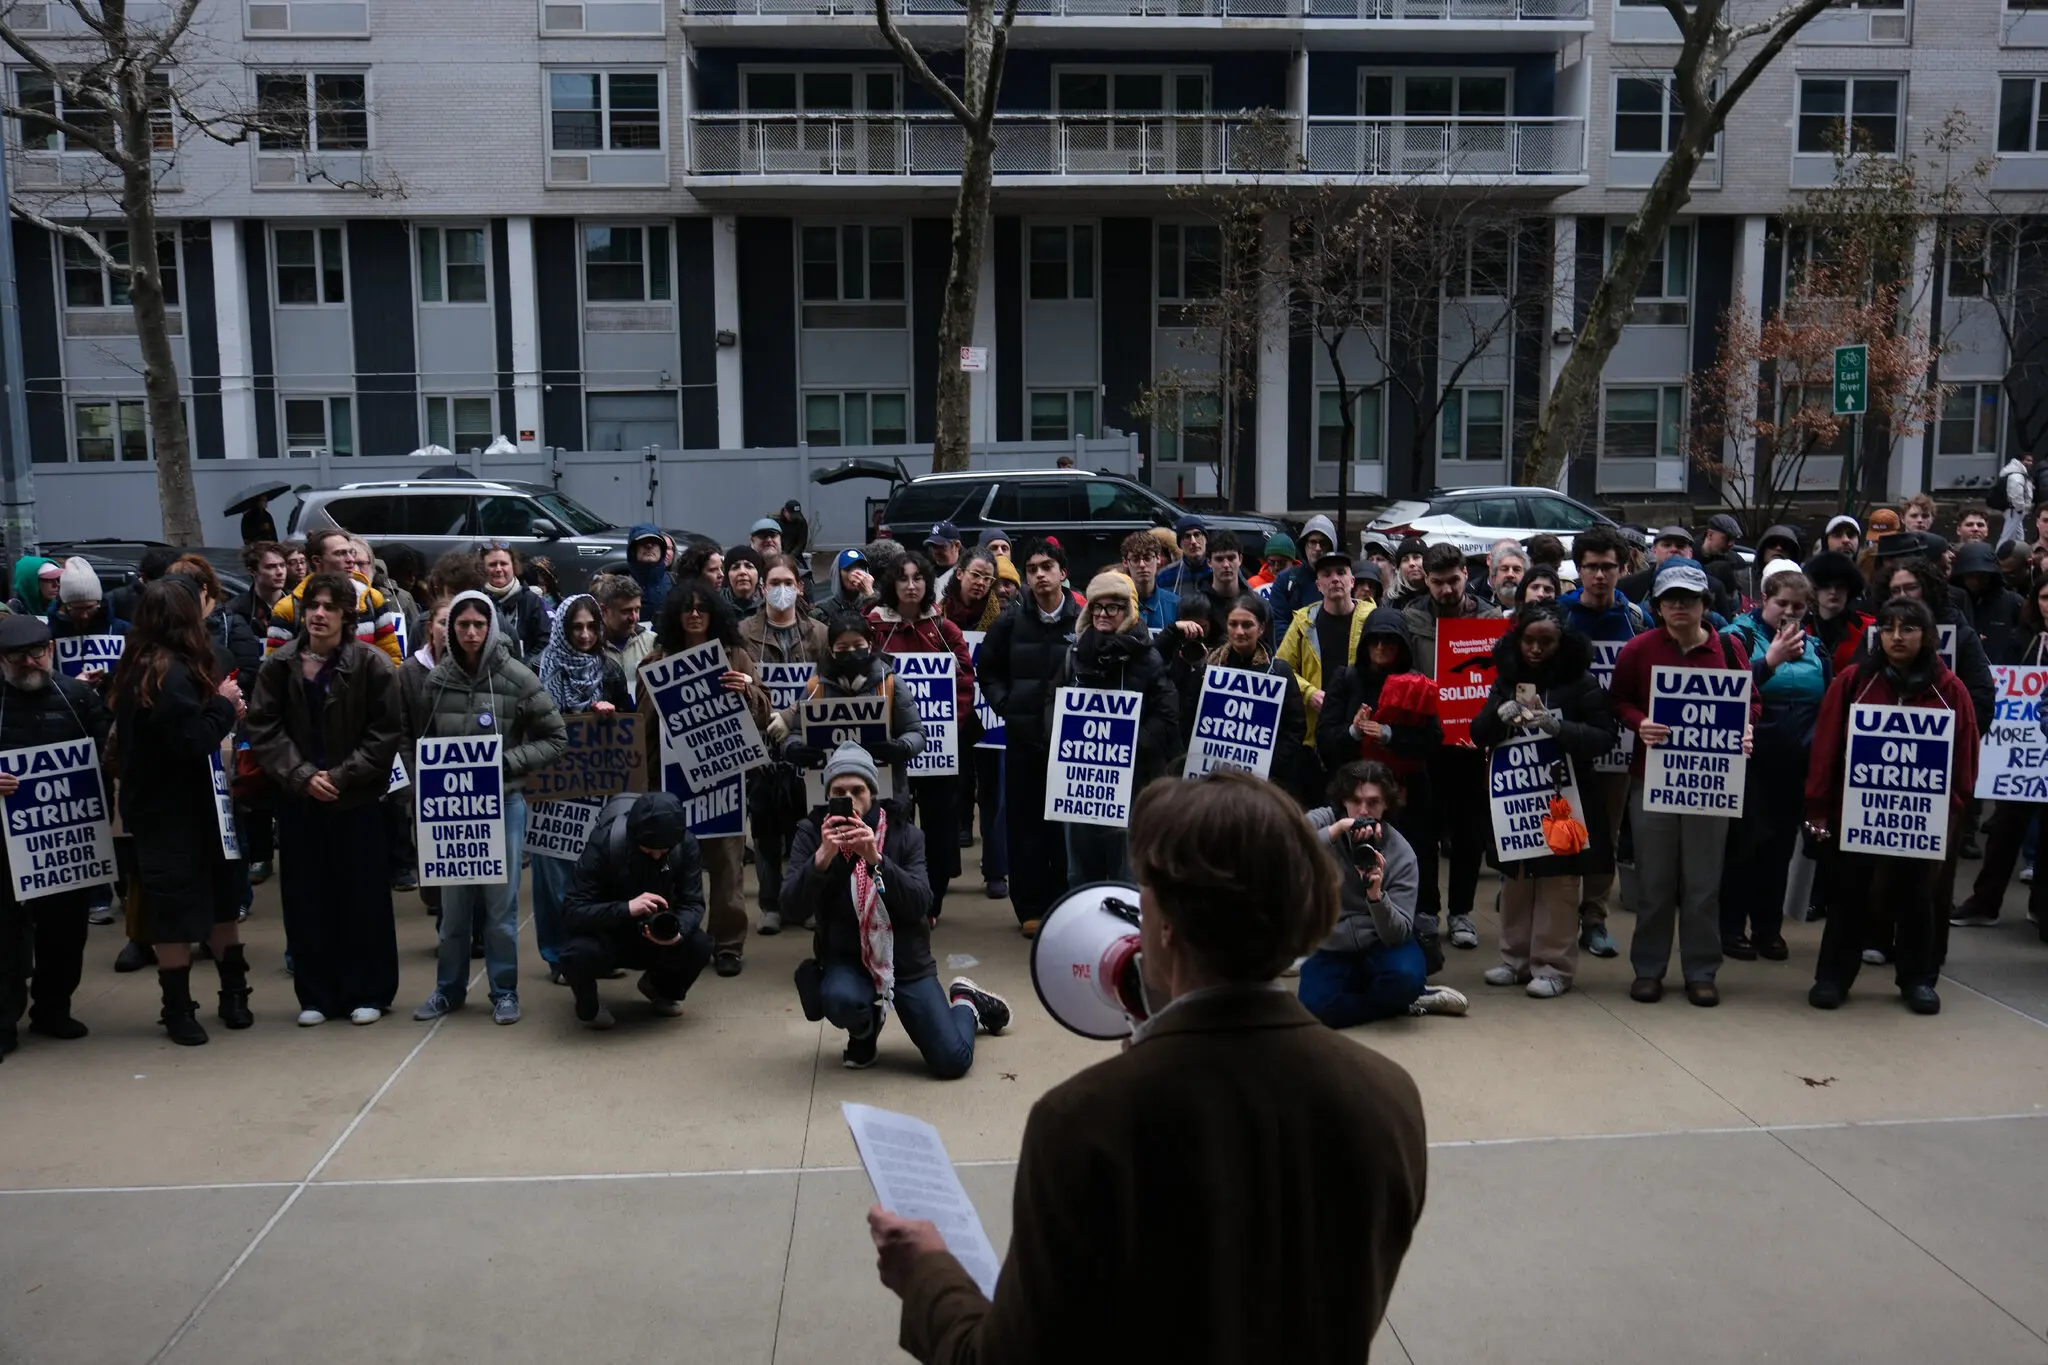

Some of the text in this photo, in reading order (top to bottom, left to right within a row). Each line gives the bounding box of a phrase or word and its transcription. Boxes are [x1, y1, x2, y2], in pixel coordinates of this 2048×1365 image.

[1840, 372, 1860, 381] East
[1840, 383, 1861, 392] River
[1459, 543, 1483, 552] HAPPY
[60, 639, 122, 659] UAW
[645, 645, 719, 688] UAW
[1470, 671, 1482, 683] In
[681, 683, 711, 704] ON
[1209, 670, 1282, 699] UAW
[1656, 672, 1747, 697] UAW
[770, 689, 796, 707] ON
[914, 700, 952, 718] IKE
[1065, 692, 1137, 716] UAW
[1224, 698, 1254, 720] ON
[667, 692, 741, 731] STRIKE
[806, 702, 885, 722] UAW
[1682, 704, 1716, 725] ON
[566, 717, 635, 748] ENTS
[685, 717, 742, 749] UNFAIR
[924, 725, 945, 738] AIR
[1083, 720, 1111, 740] ON
[1199, 716, 1272, 745] STRIKE
[1855, 710, 1950, 737] UAW
[832, 727, 862, 745] ON
[1667, 725, 1742, 750] TRIKE
[1984, 725, 2037, 746] MORE
[1, 742, 92, 776] UAW
[421, 741, 498, 765] UAW
[694, 733, 746, 763] LABOR
[1060, 739, 1131, 764] STRIKE
[1203, 741, 1259, 765] UNFAIR
[1508, 743, 1539, 767] ON
[1881, 741, 1918, 763] ON
[689, 744, 764, 783] PRACTICE
[906, 755, 955, 769] ACTICE
[1663, 753, 1730, 773] UNFAIR
[443, 771, 474, 793] ON
[1066, 766, 1120, 785] UNFAIR
[1665, 771, 1725, 791] LABOR
[1852, 763, 1944, 790] STRIKE
[1992, 773, 2048, 798] ESTA
[35, 776, 72, 802] ON
[1067, 782, 1115, 801] LABOR
[1650, 788, 1738, 810] PRACTICE
[422, 794, 497, 818] STRIKE
[532, 800, 591, 822] UNFAIR
[683, 783, 740, 828] TRIKE
[1054, 798, 1125, 819] PRACTICE
[1504, 794, 1554, 816] UNFAI
[1861, 792, 1932, 813] UNFAIR
[11, 797, 101, 831] STRIKE
[1510, 814, 1550, 833] LAB
[1863, 811, 1927, 832] LABOR
[432, 823, 491, 841] UNFAIR
[531, 815, 584, 838] LABOR
[26, 826, 96, 852] UNFAIR
[524, 831, 588, 854] RACTIC
[1501, 832, 1544, 852] PRAC
[1847, 828, 1941, 852] PRACTICE
[33, 845, 96, 871] LABOR
[436, 842, 489, 859] LABOR
[20, 859, 113, 891] PRACTICE
[425, 860, 502, 878] PRACTICE
[1072, 964, 1091, 978] PYLE
